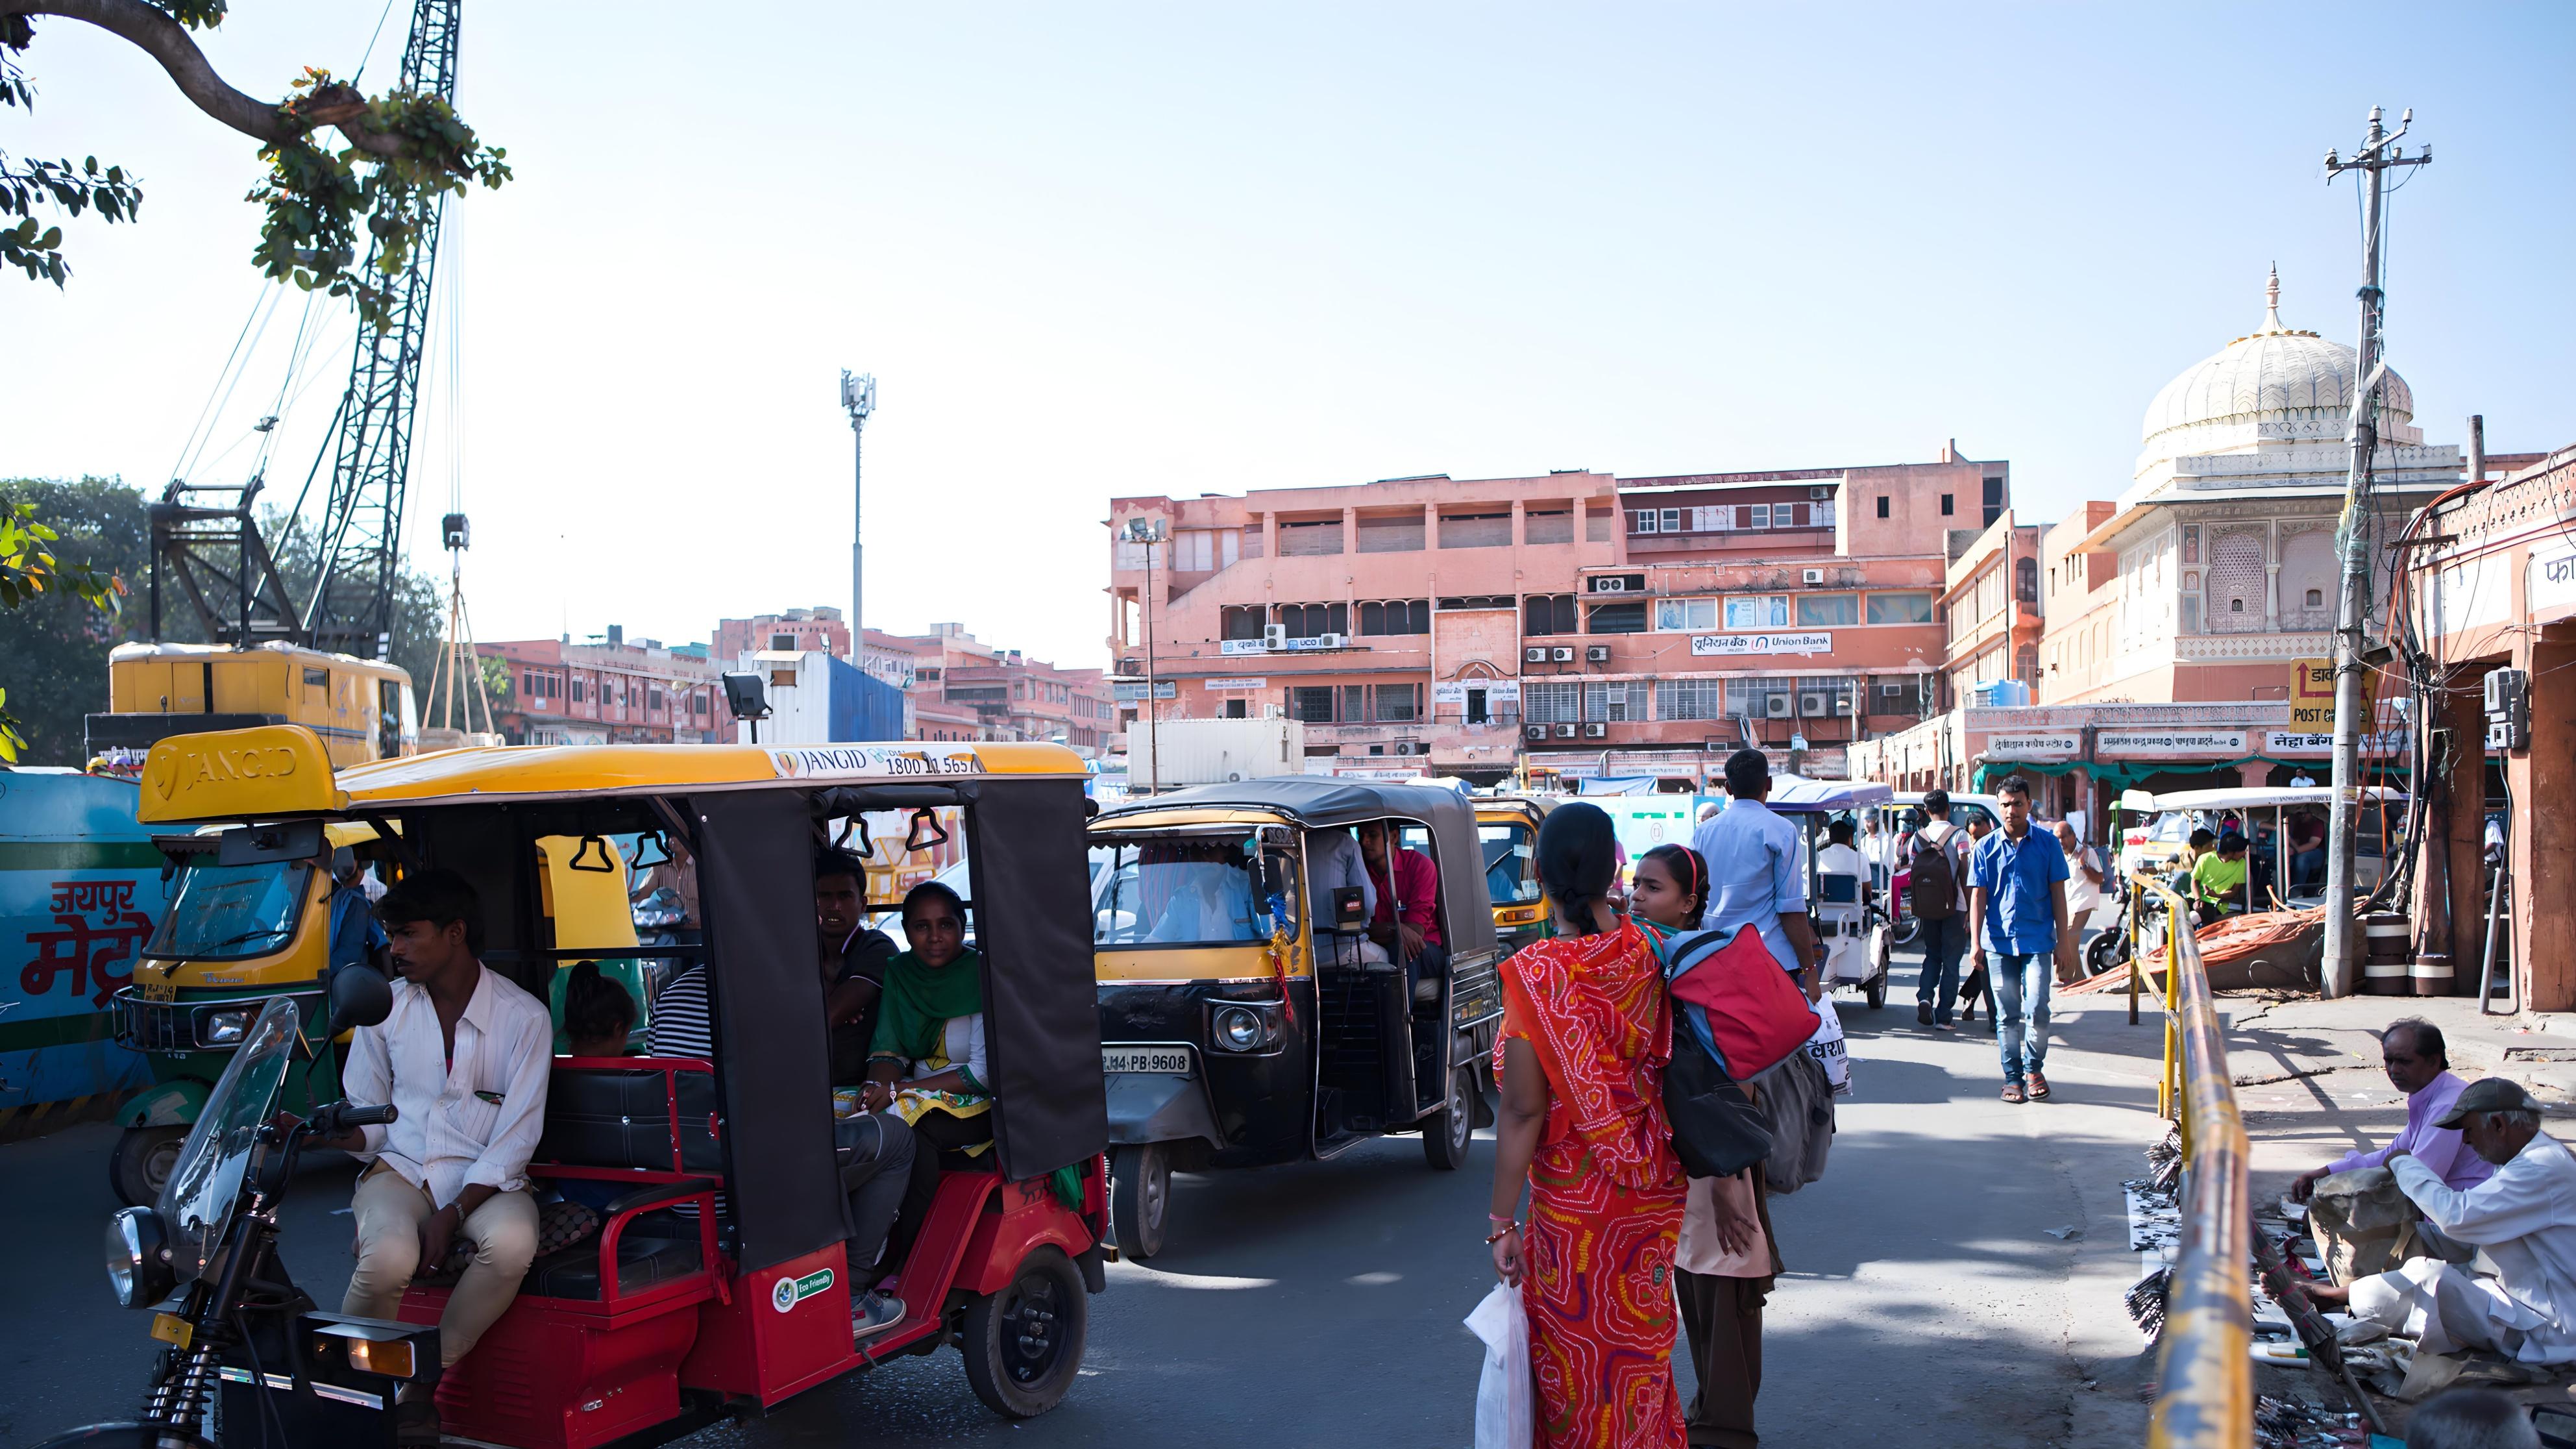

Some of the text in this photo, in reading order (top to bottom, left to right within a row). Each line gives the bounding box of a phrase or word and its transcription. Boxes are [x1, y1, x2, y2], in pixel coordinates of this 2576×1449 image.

[1772, 636, 1828, 646] Union Bank
[2294, 708, 2322, 723] POST
[186, 747, 297, 791] JANGID
[800, 749, 867, 778] JANGID
[886, 758, 920, 774] 1800
[49, 880, 136, 926] जयपुर
[1131, 1056, 1147, 1071] PB
[1151, 1055, 1186, 1070] 9608
[799, 1274, 830, 1293] Eco Friendly
